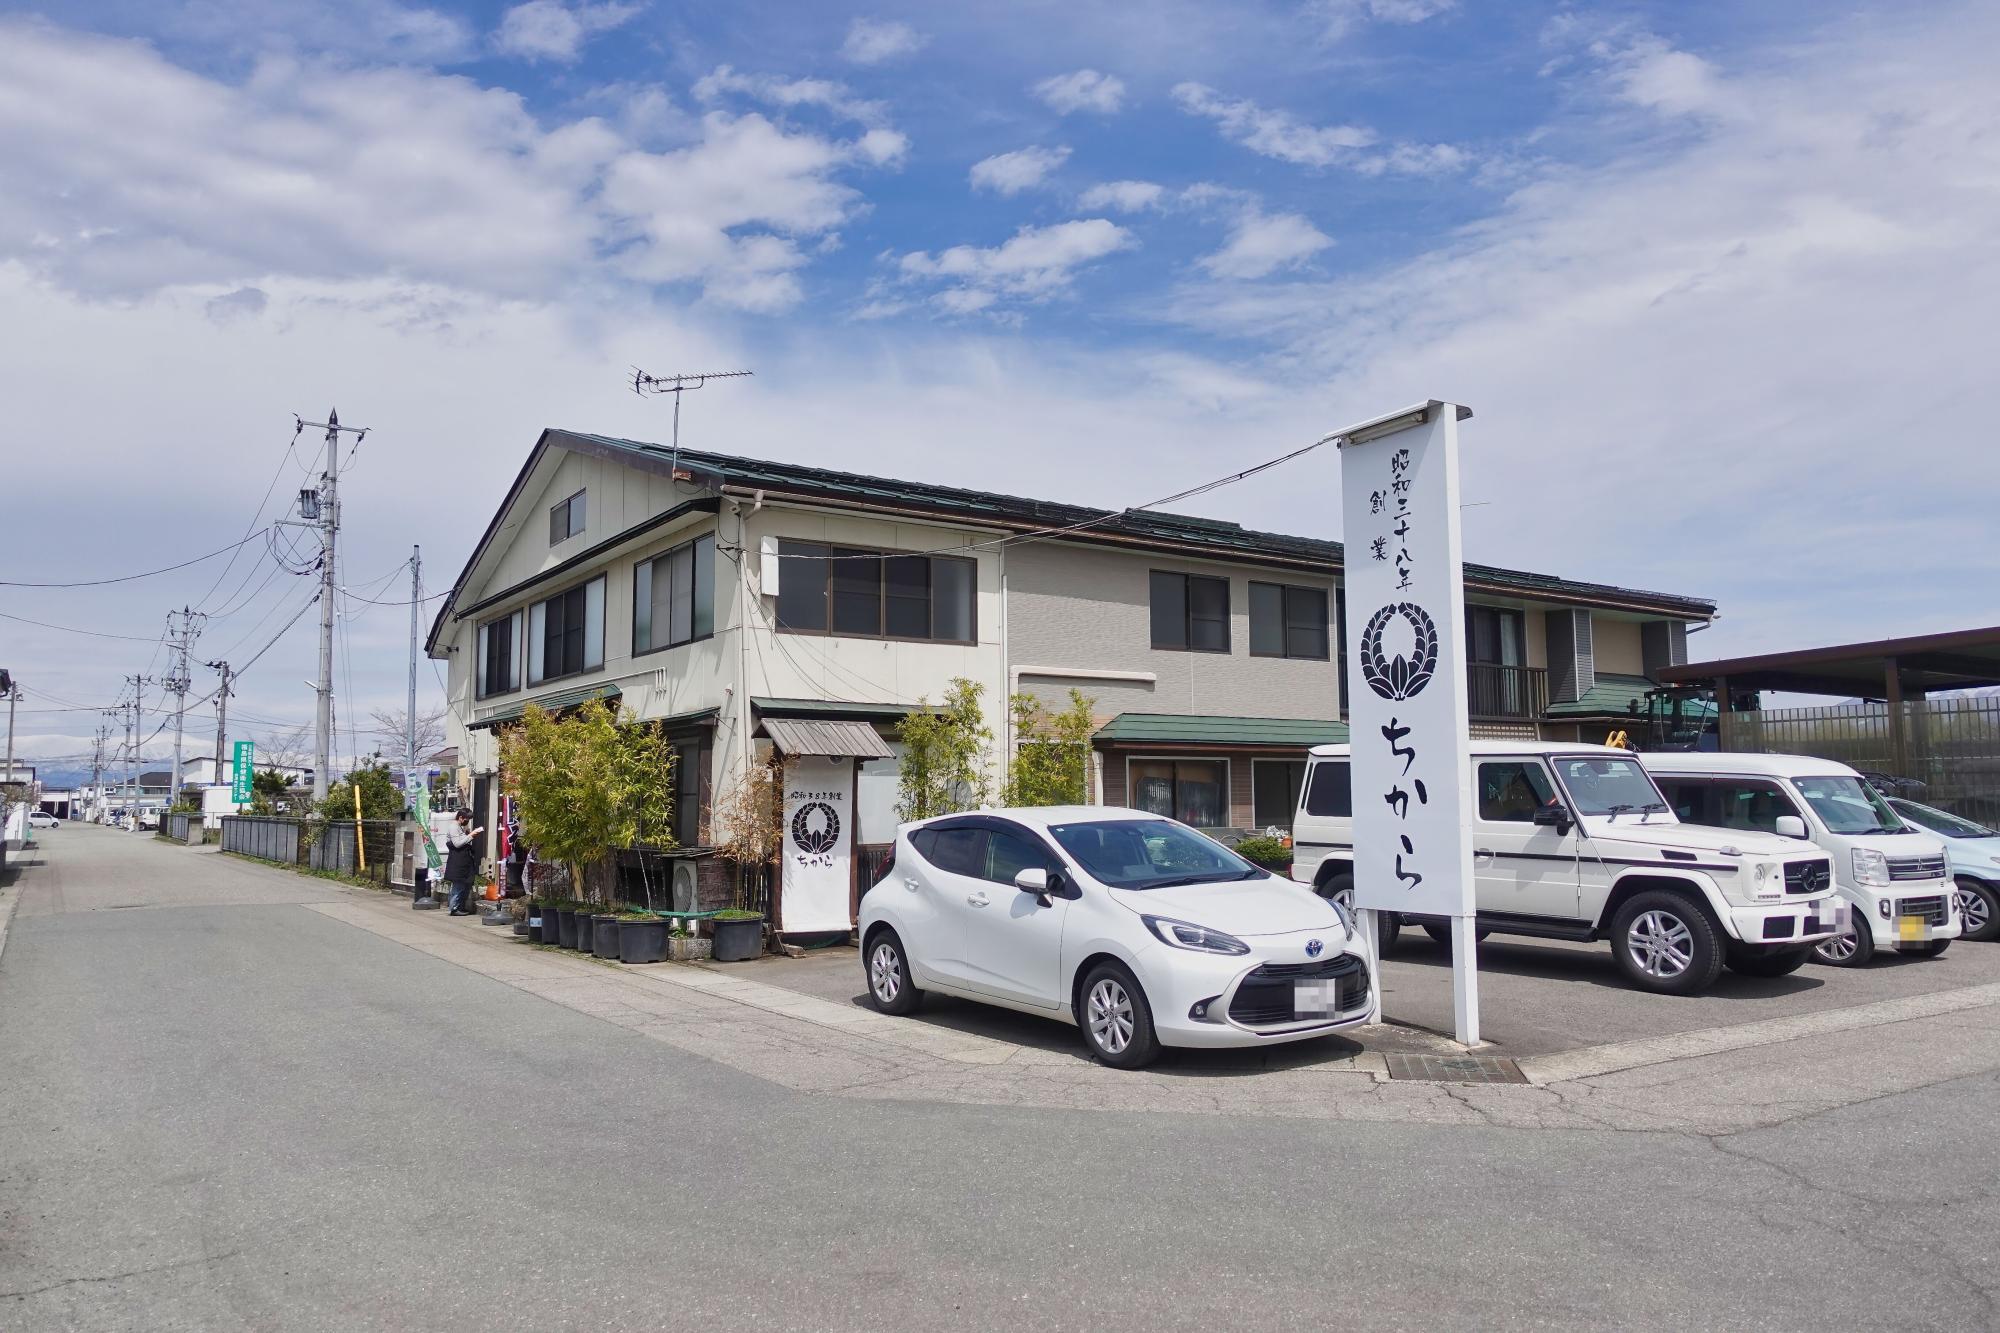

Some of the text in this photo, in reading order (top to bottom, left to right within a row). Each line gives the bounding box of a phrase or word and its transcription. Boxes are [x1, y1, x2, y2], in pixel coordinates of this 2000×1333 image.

[1370, 489, 1388, 561] 創業
[1391, 448, 1413, 592] 昭和三十八年
[1381, 717, 1428, 890] ちから
[797, 854, 833, 869] ちから
